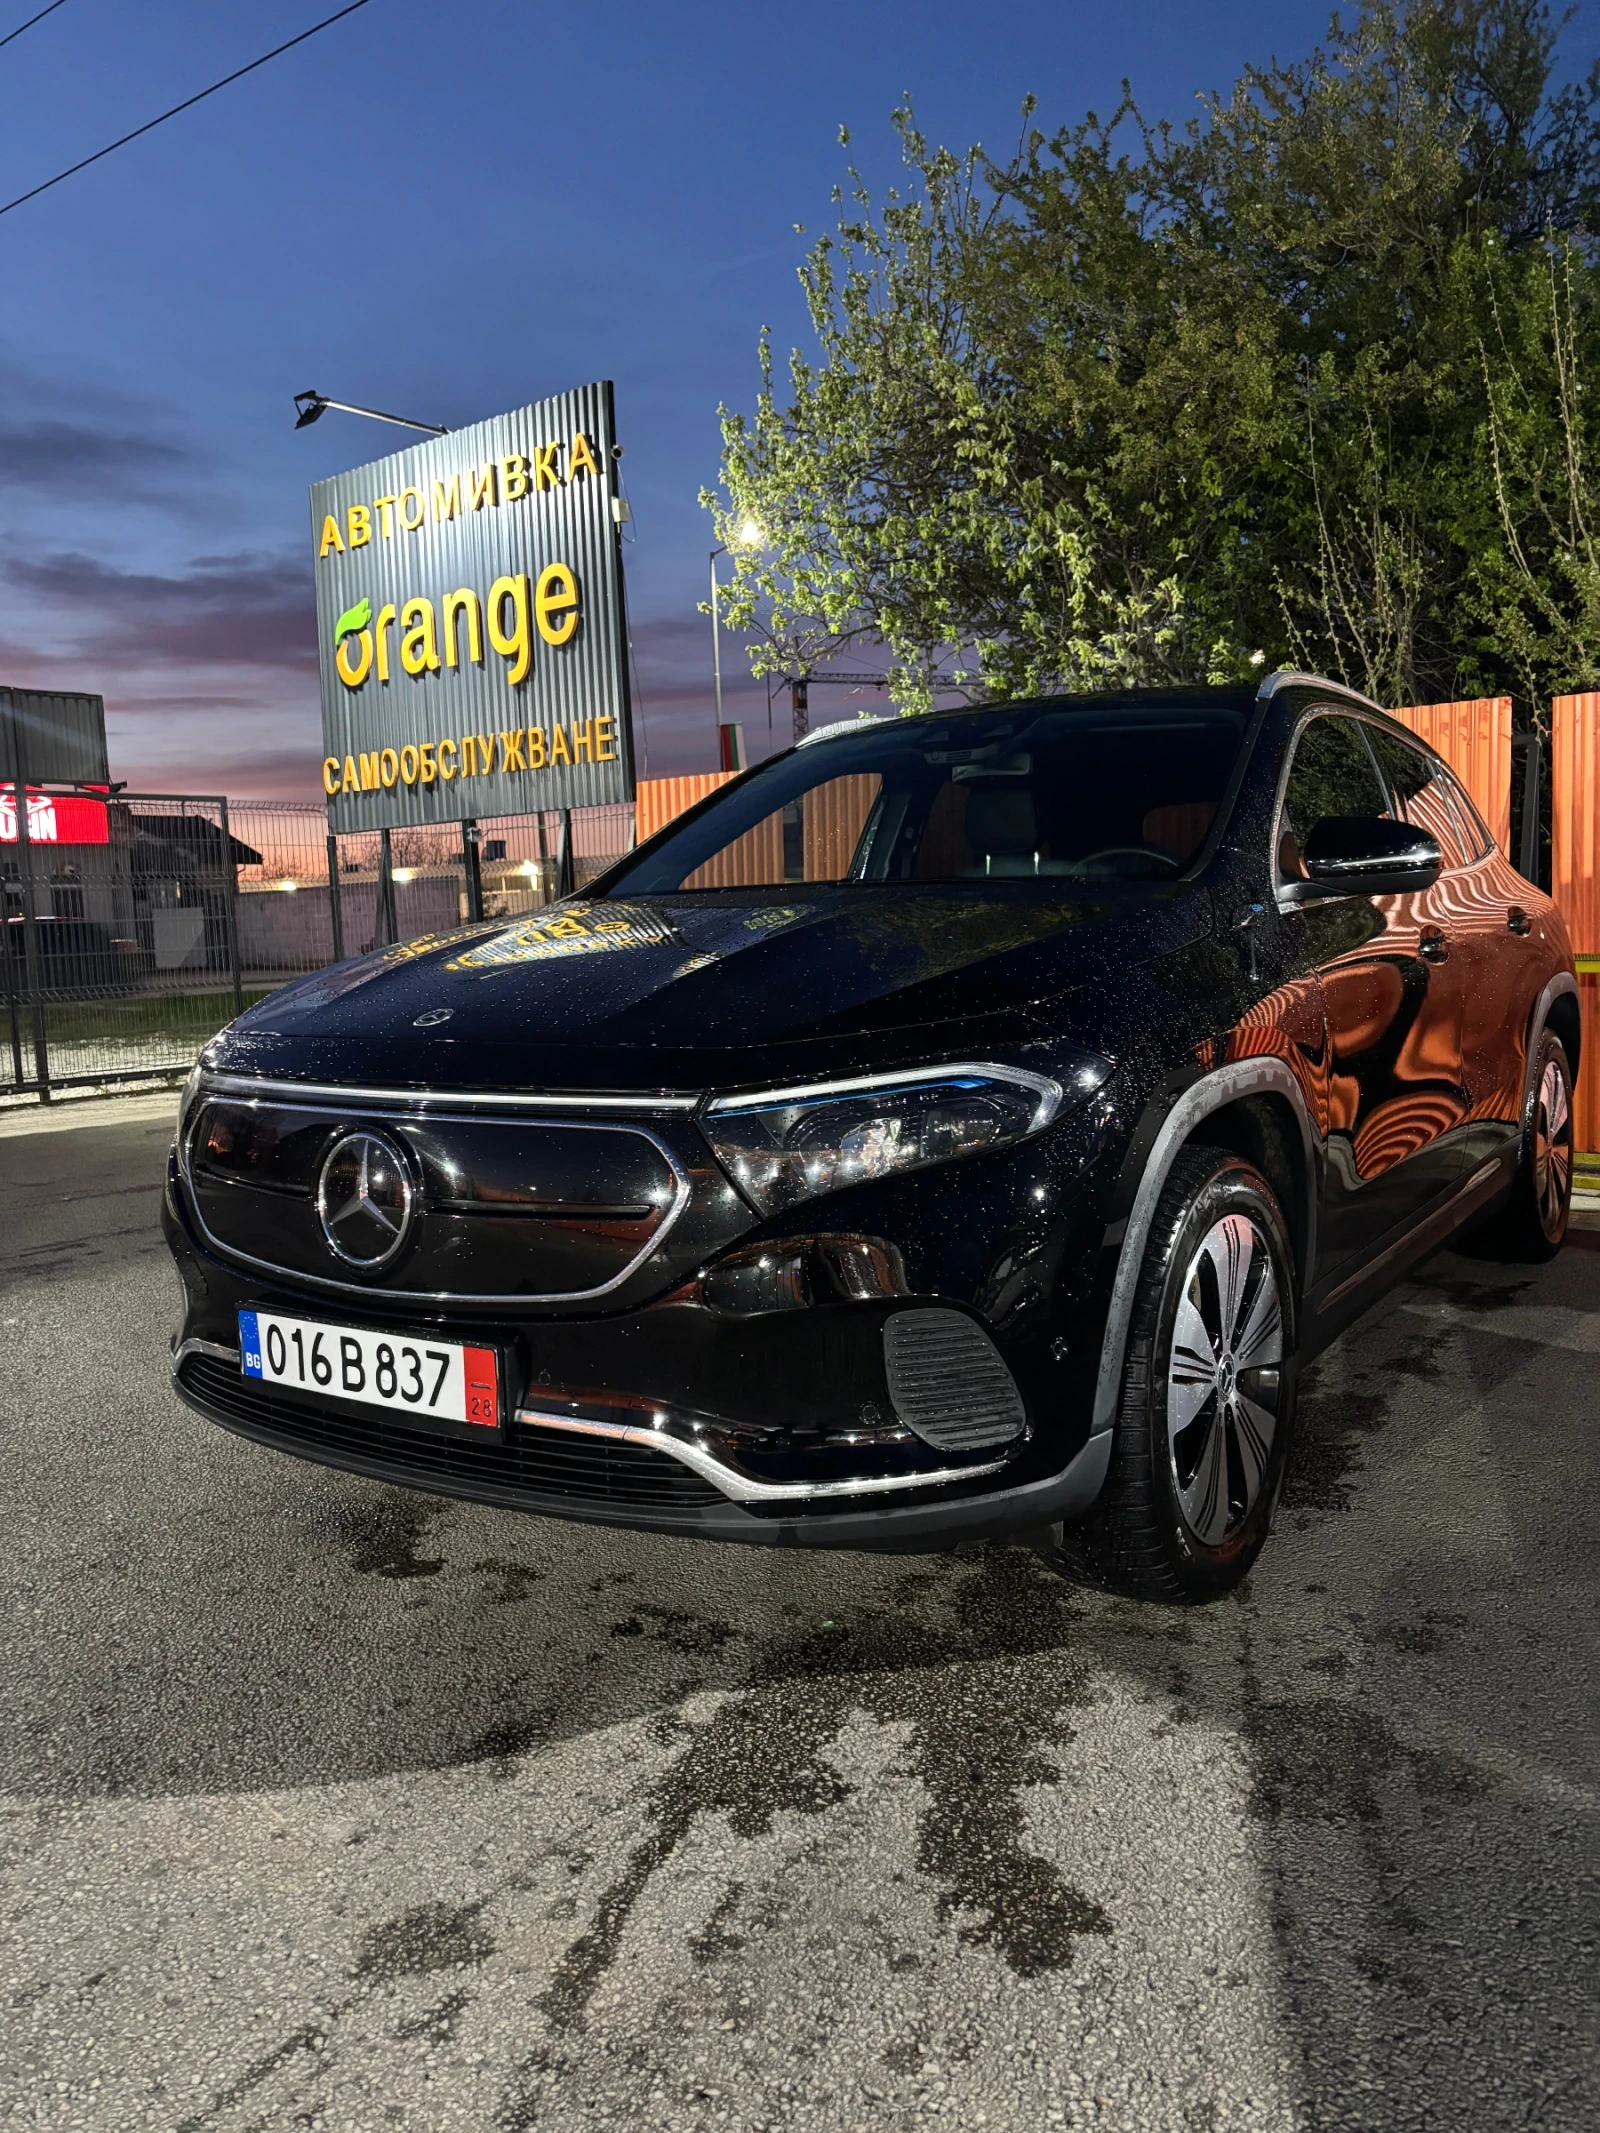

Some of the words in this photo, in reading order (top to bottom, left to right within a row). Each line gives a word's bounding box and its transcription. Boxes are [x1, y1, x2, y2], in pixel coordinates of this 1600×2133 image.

[319, 432, 600, 557] АВТОМИВКА
[336, 562, 581, 687] orange
[322, 715, 617, 795] САМООБСЛУЖВАНЕ
[246, 1351, 261, 1370] BG
[266, 1323, 451, 1407] 016B837
[471, 1396, 492, 1418] 28
